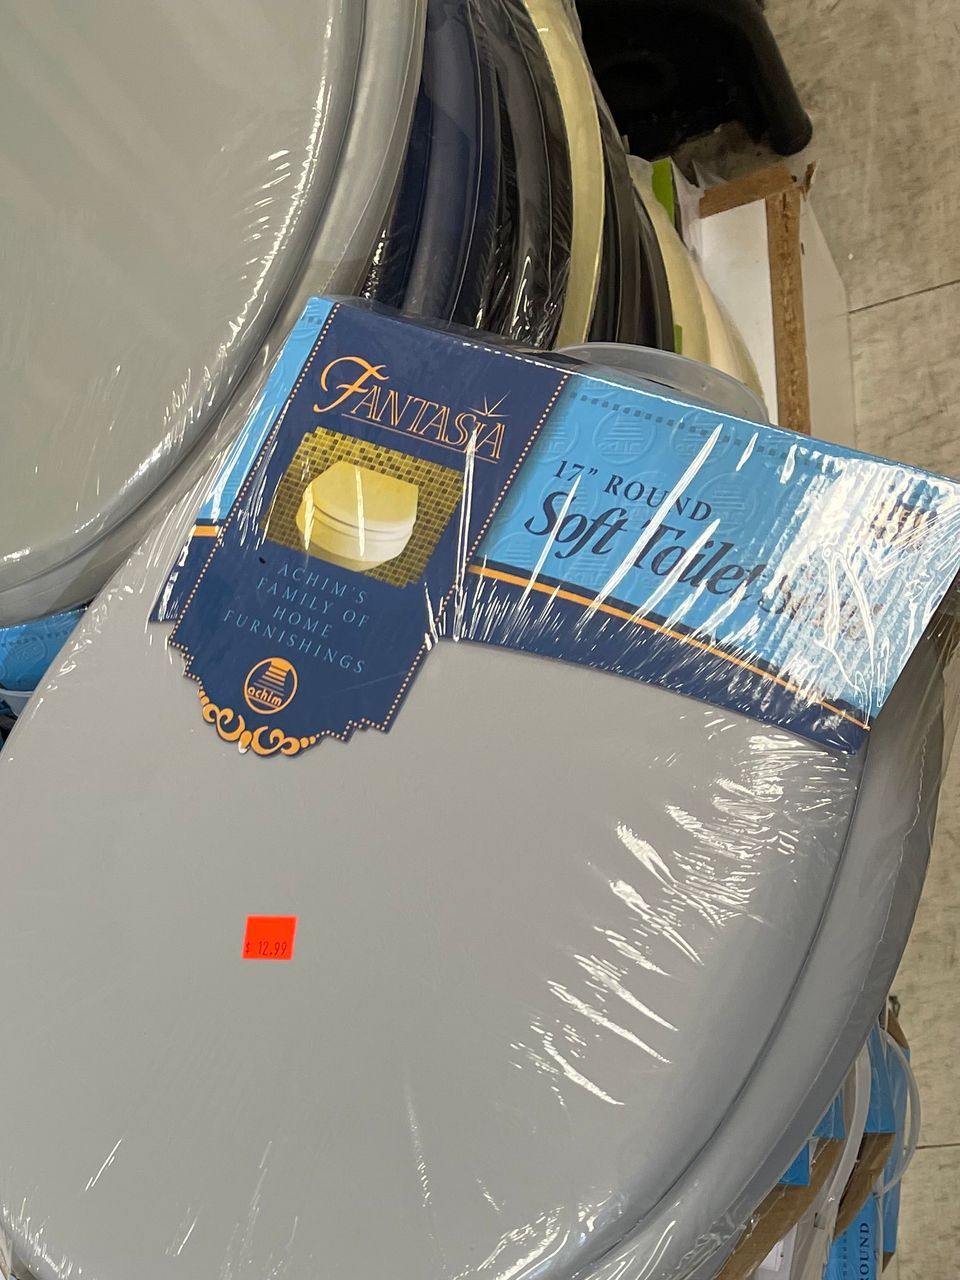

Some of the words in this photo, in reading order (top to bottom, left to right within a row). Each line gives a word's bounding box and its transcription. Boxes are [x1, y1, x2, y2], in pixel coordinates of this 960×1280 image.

[313, 356, 506, 460] FANTASIA
[604, 474, 712, 521] ROUND
[524, 490, 628, 559] Soft
[630, 520, 767, 602] Toilet
[257, 577, 334, 614] FAMILY
[342, 608, 369, 628] OF
[278, 563, 367, 604] ACHIM'S
[223, 609, 365, 673] FURNISHINGS
[272, 606, 332, 638] HOME
[248, 686, 283, 706] achim
[259, 940, 288, 956] 12.99
